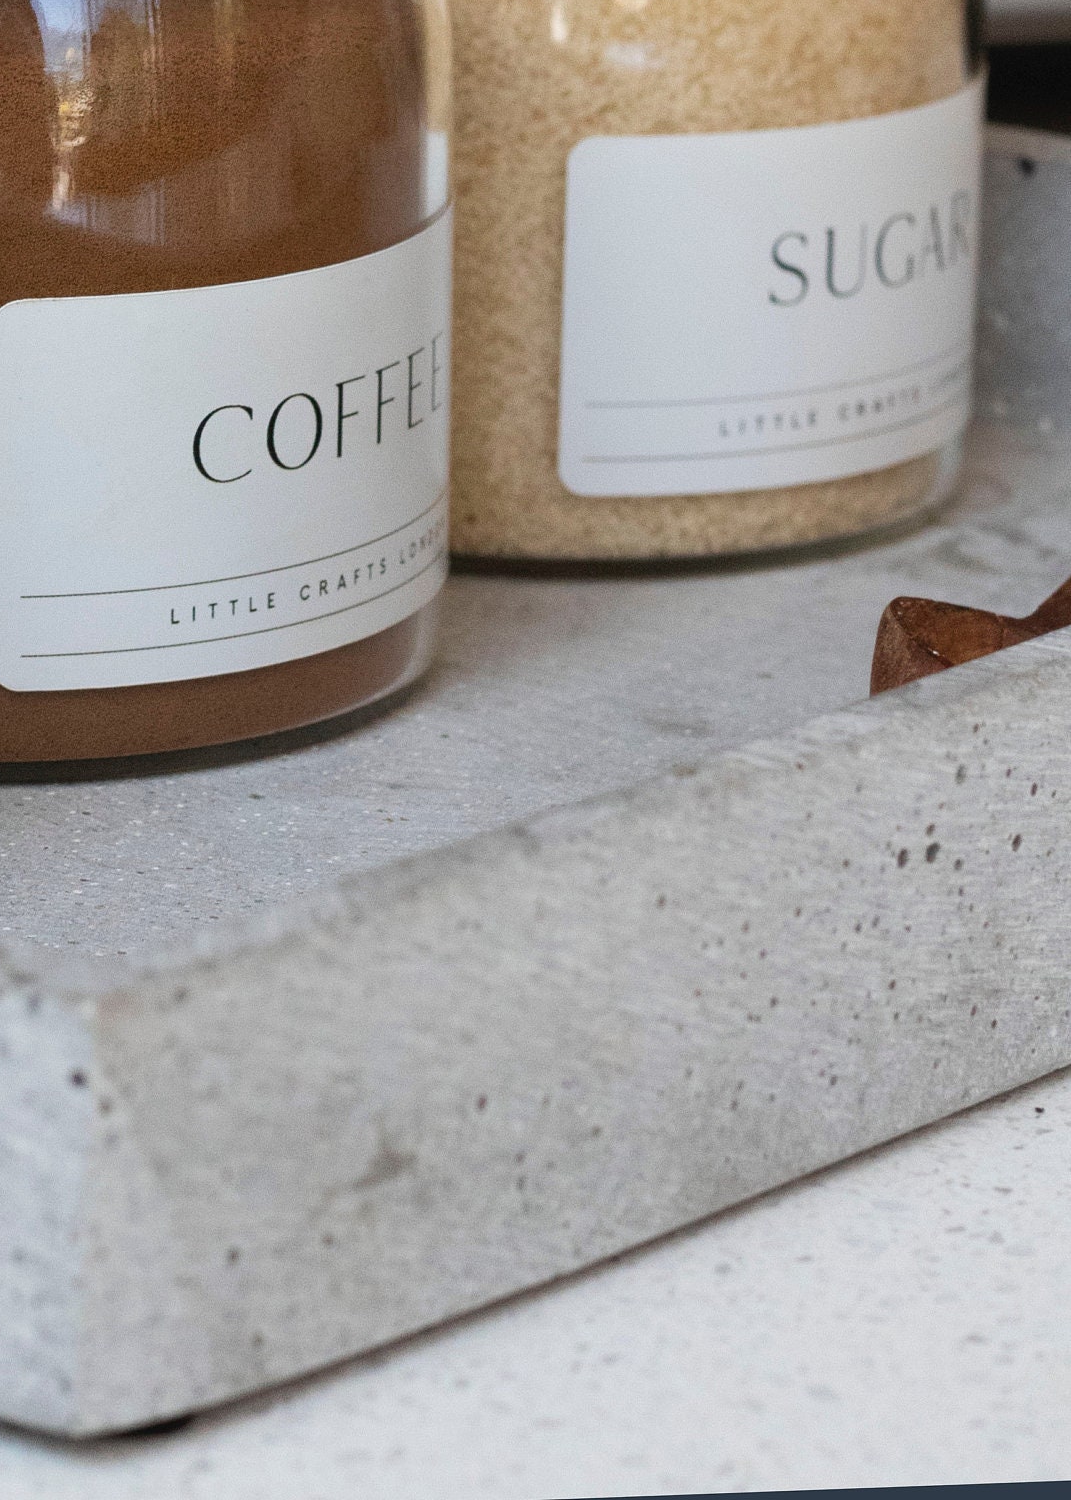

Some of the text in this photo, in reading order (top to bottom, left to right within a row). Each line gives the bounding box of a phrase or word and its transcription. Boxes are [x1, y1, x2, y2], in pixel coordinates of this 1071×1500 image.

[767, 188, 970, 307] SUGAR
[192, 331, 444, 484] COFFEE
[170, 592, 276, 625] LITTLE
[299, 557, 387, 601] CRAFTS
